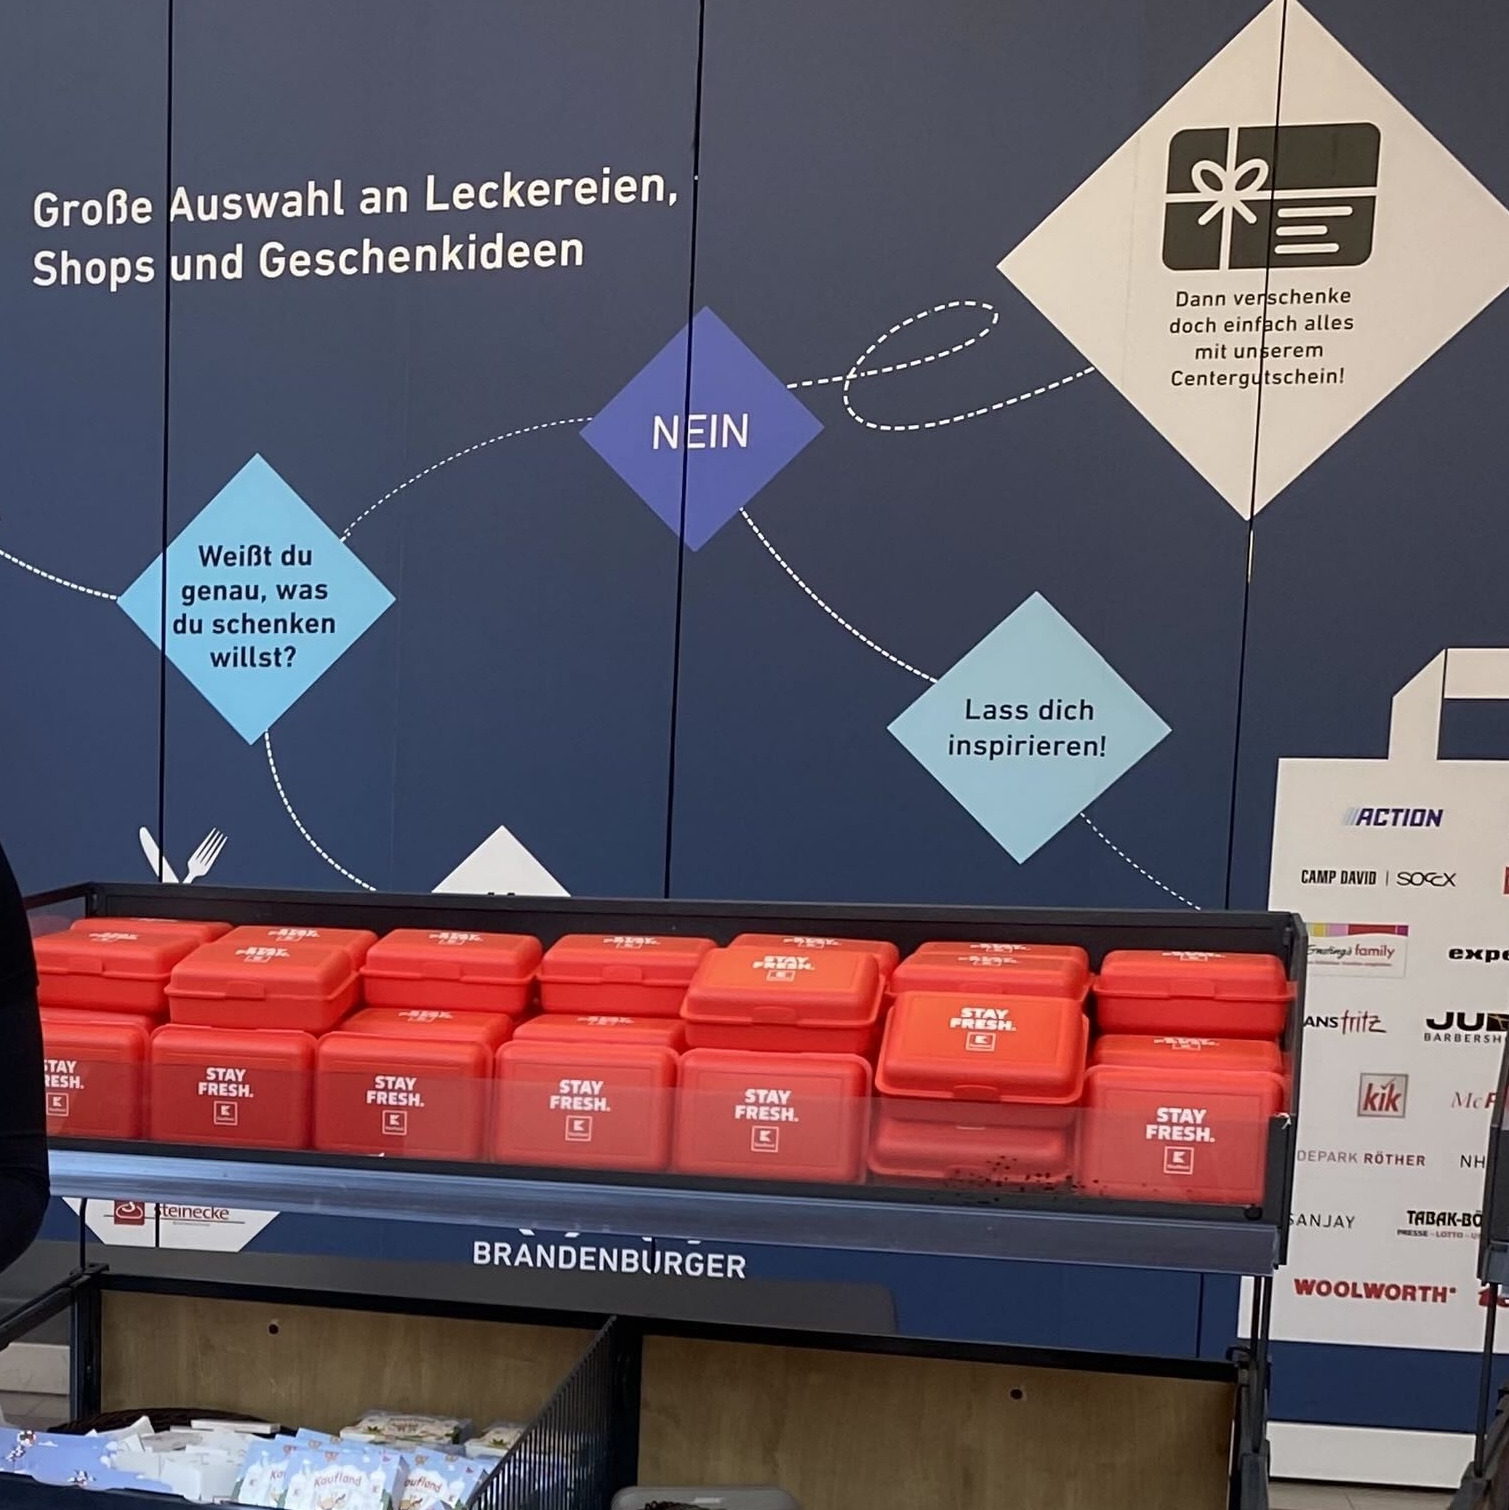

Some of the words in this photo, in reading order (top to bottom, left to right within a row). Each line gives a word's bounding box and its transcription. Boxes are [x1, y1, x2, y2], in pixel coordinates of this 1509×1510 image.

[32, 189, 154, 228] Große
[169, 179, 345, 222] Auswahl
[360, 186, 408, 214] an
[426, 167, 679, 215] Leckereien,
[32, 248, 155, 292] Shops
[169, 244, 244, 281] und
[259, 232, 584, 279] Geschenkideen
[1176, 290, 1227, 307] Dann
[1233, 287, 1352, 307] verschenke
[1169, 317, 1218, 334] doch
[1223, 315, 1298, 333] einfach
[1304, 314, 1354, 332] alles
[1194, 343, 1227, 361] mit
[1233, 344, 1324, 361] unserem
[1170, 368, 1345, 390] Centergutschein!
[652, 413, 750, 450] NEIN
[198, 545, 273, 568] Weißt
[280, 545, 313, 568] du
[181, 580, 267, 606] genau,
[276, 581, 329, 601] was
[172, 612, 204, 635] du
[211, 611, 336, 636] schenken
[209, 645, 297, 669] willst?
[965, 699, 1031, 722] Lass
[1038, 698, 1095, 721] dich
[948, 735, 1107, 762] inspirieren!
[1355, 807, 1444, 827] ACTION
[1301, 869, 1336, 884] CAMP
[1340, 870, 1377, 885] DAVID
[763, 954, 810, 967] STAY
[1354, 943, 1395, 960] family
[960, 1007, 1009, 1020] STAY
[949, 1017, 1017, 1032] FRESH.
[1424, 1032, 1504, 1044] BARBERSH
[44, 1074, 85, 1089] RESH.
[206, 1067, 247, 1082] STAY
[374, 1075, 418, 1091] STAY
[198, 1082, 254, 1098] FRESH.
[559, 1079, 604, 1096] STAY
[1362, 1080, 1402, 1113] kik
[366, 1090, 425, 1108] FRESH.
[549, 1095, 611, 1112] FRESH.
[744, 1088, 791, 1106] STAY
[734, 1104, 799, 1123] FRESH.
[1156, 1107, 1207, 1124] STAY
[1146, 1124, 1216, 1143] FRESH.
[1297, 1149, 1358, 1164] DEPARK
[1363, 1150, 1426, 1167] RÖTHER
[1407, 1209, 1482, 1228] TABAK-BÖ
[472, 1240, 747, 1279] BRANDENBURGER
[1293, 1278, 1448, 1303] WOOLWORTH
[313, 1471, 363, 1487] Kaufland
[403, 1475, 442, 1493] aufland
